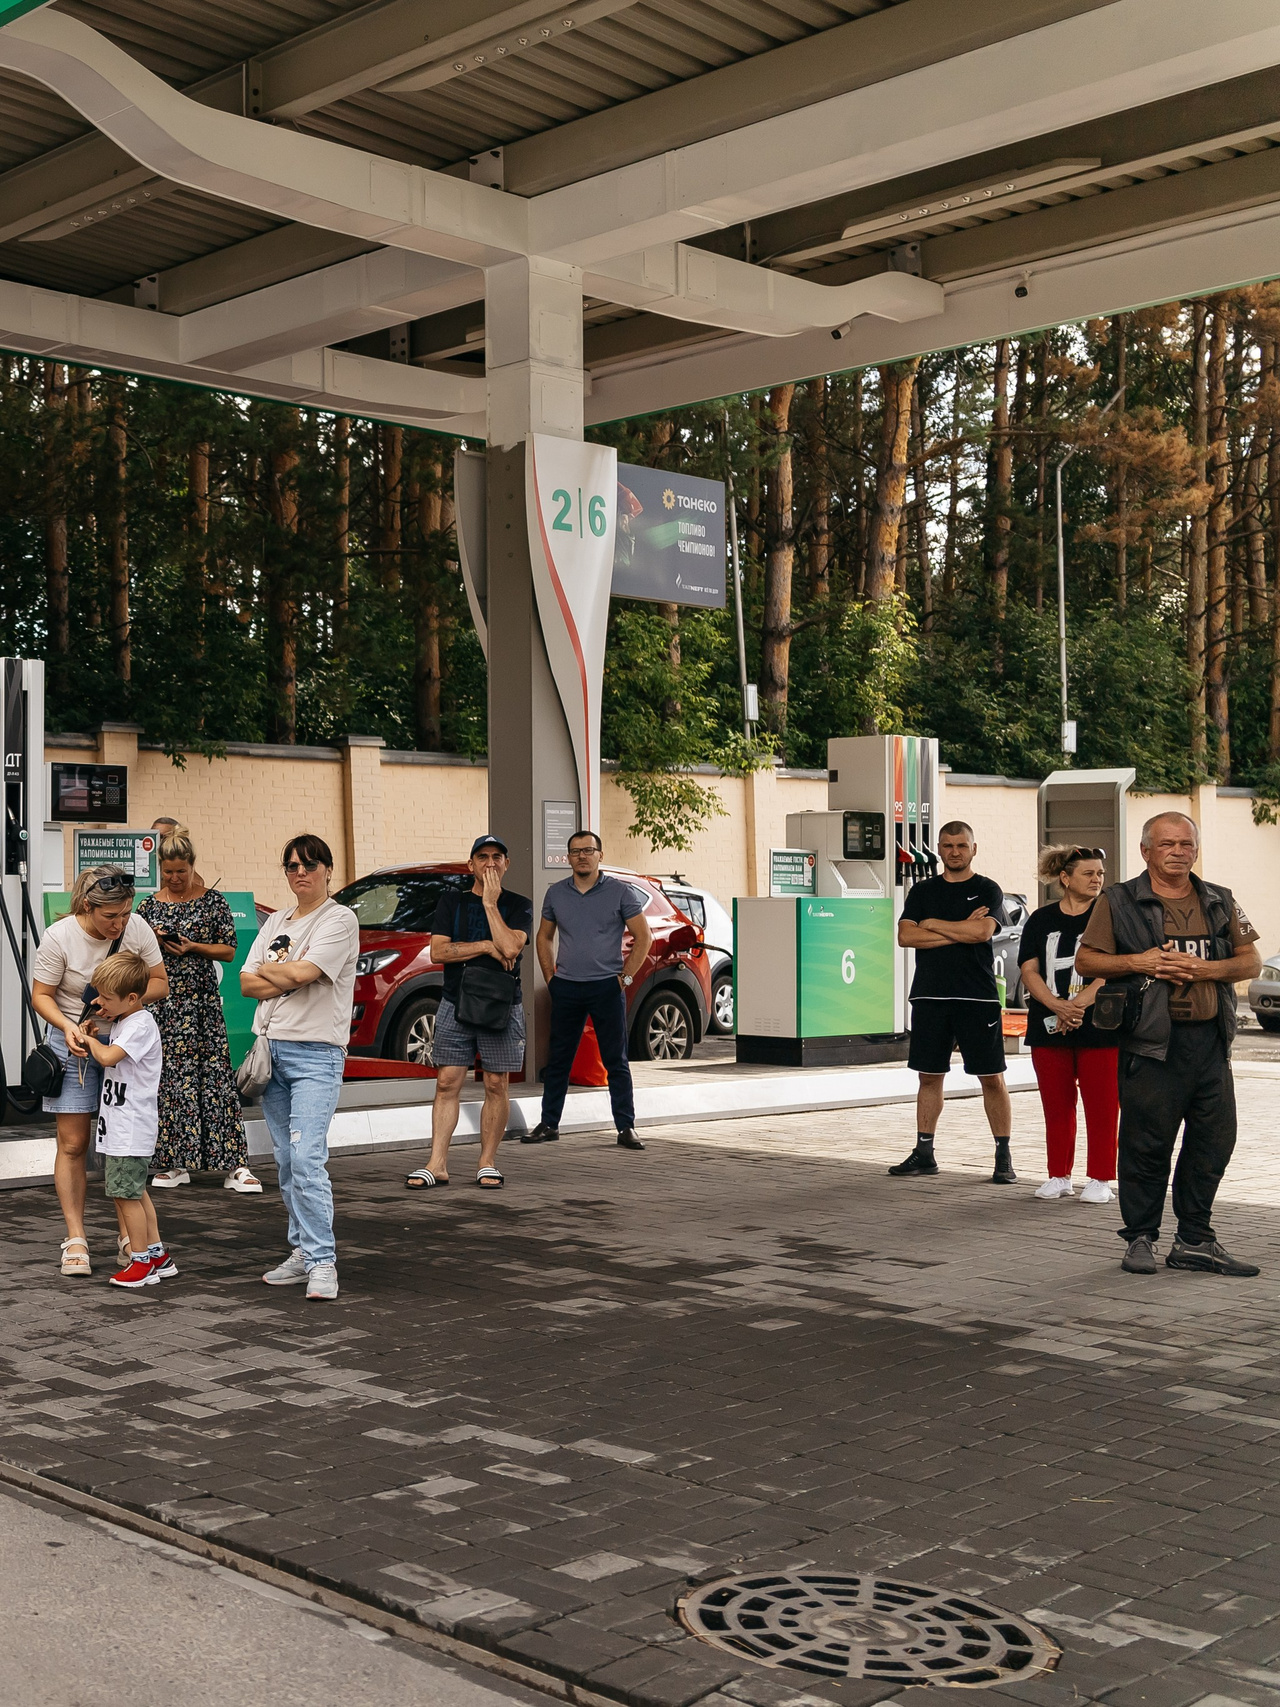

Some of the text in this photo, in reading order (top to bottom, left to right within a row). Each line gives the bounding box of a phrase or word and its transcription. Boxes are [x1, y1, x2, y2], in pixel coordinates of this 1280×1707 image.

[678, 521, 706, 538] ТОПЛИВО
[5, 753, 22, 767] ДТ
[894, 801, 903, 812] 95
[908, 802, 917, 813] 92
[921, 802, 930, 813] ДТ
[80, 837, 115, 847] УВАЖАЕМЫЕ
[80, 849, 132, 858] НАПОМИНАЕМ ВАМ
[841, 949, 856, 985] 6
